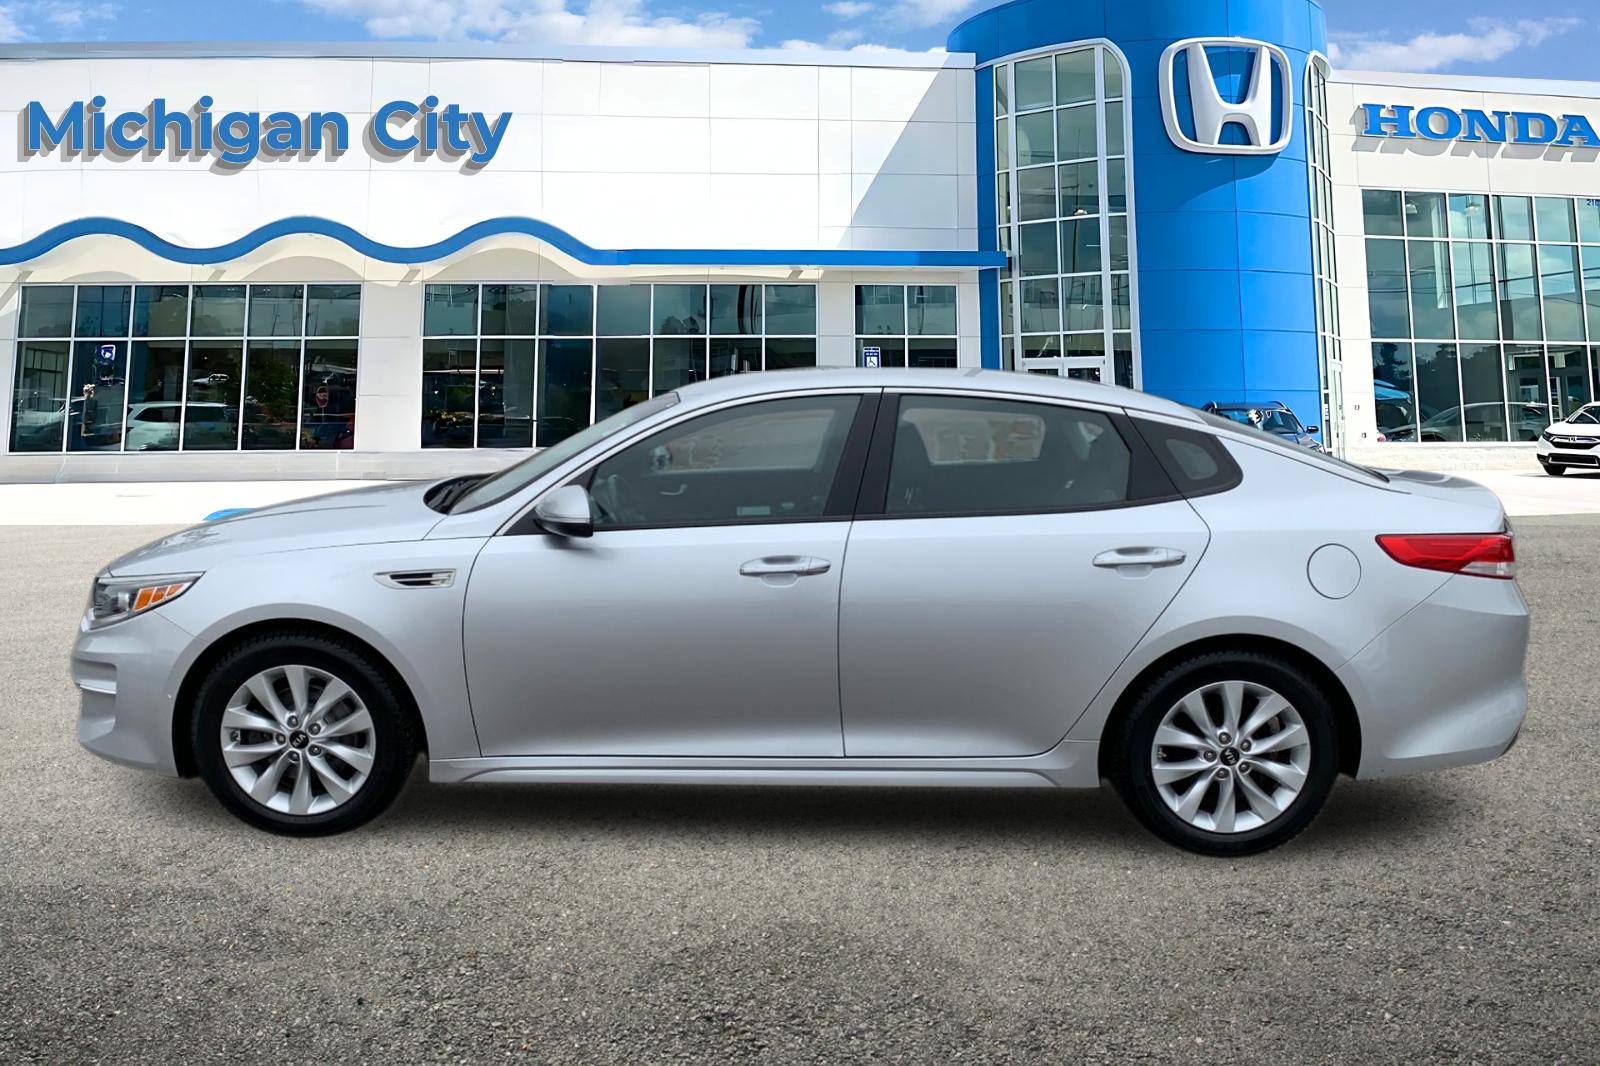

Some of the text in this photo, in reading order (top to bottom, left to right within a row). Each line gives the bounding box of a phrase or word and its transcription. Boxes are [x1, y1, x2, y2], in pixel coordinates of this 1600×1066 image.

[28, 95, 513, 164] Michigan City
[1361, 103, 1600, 146] HONDA
[292, 734, 307, 747] KIA
